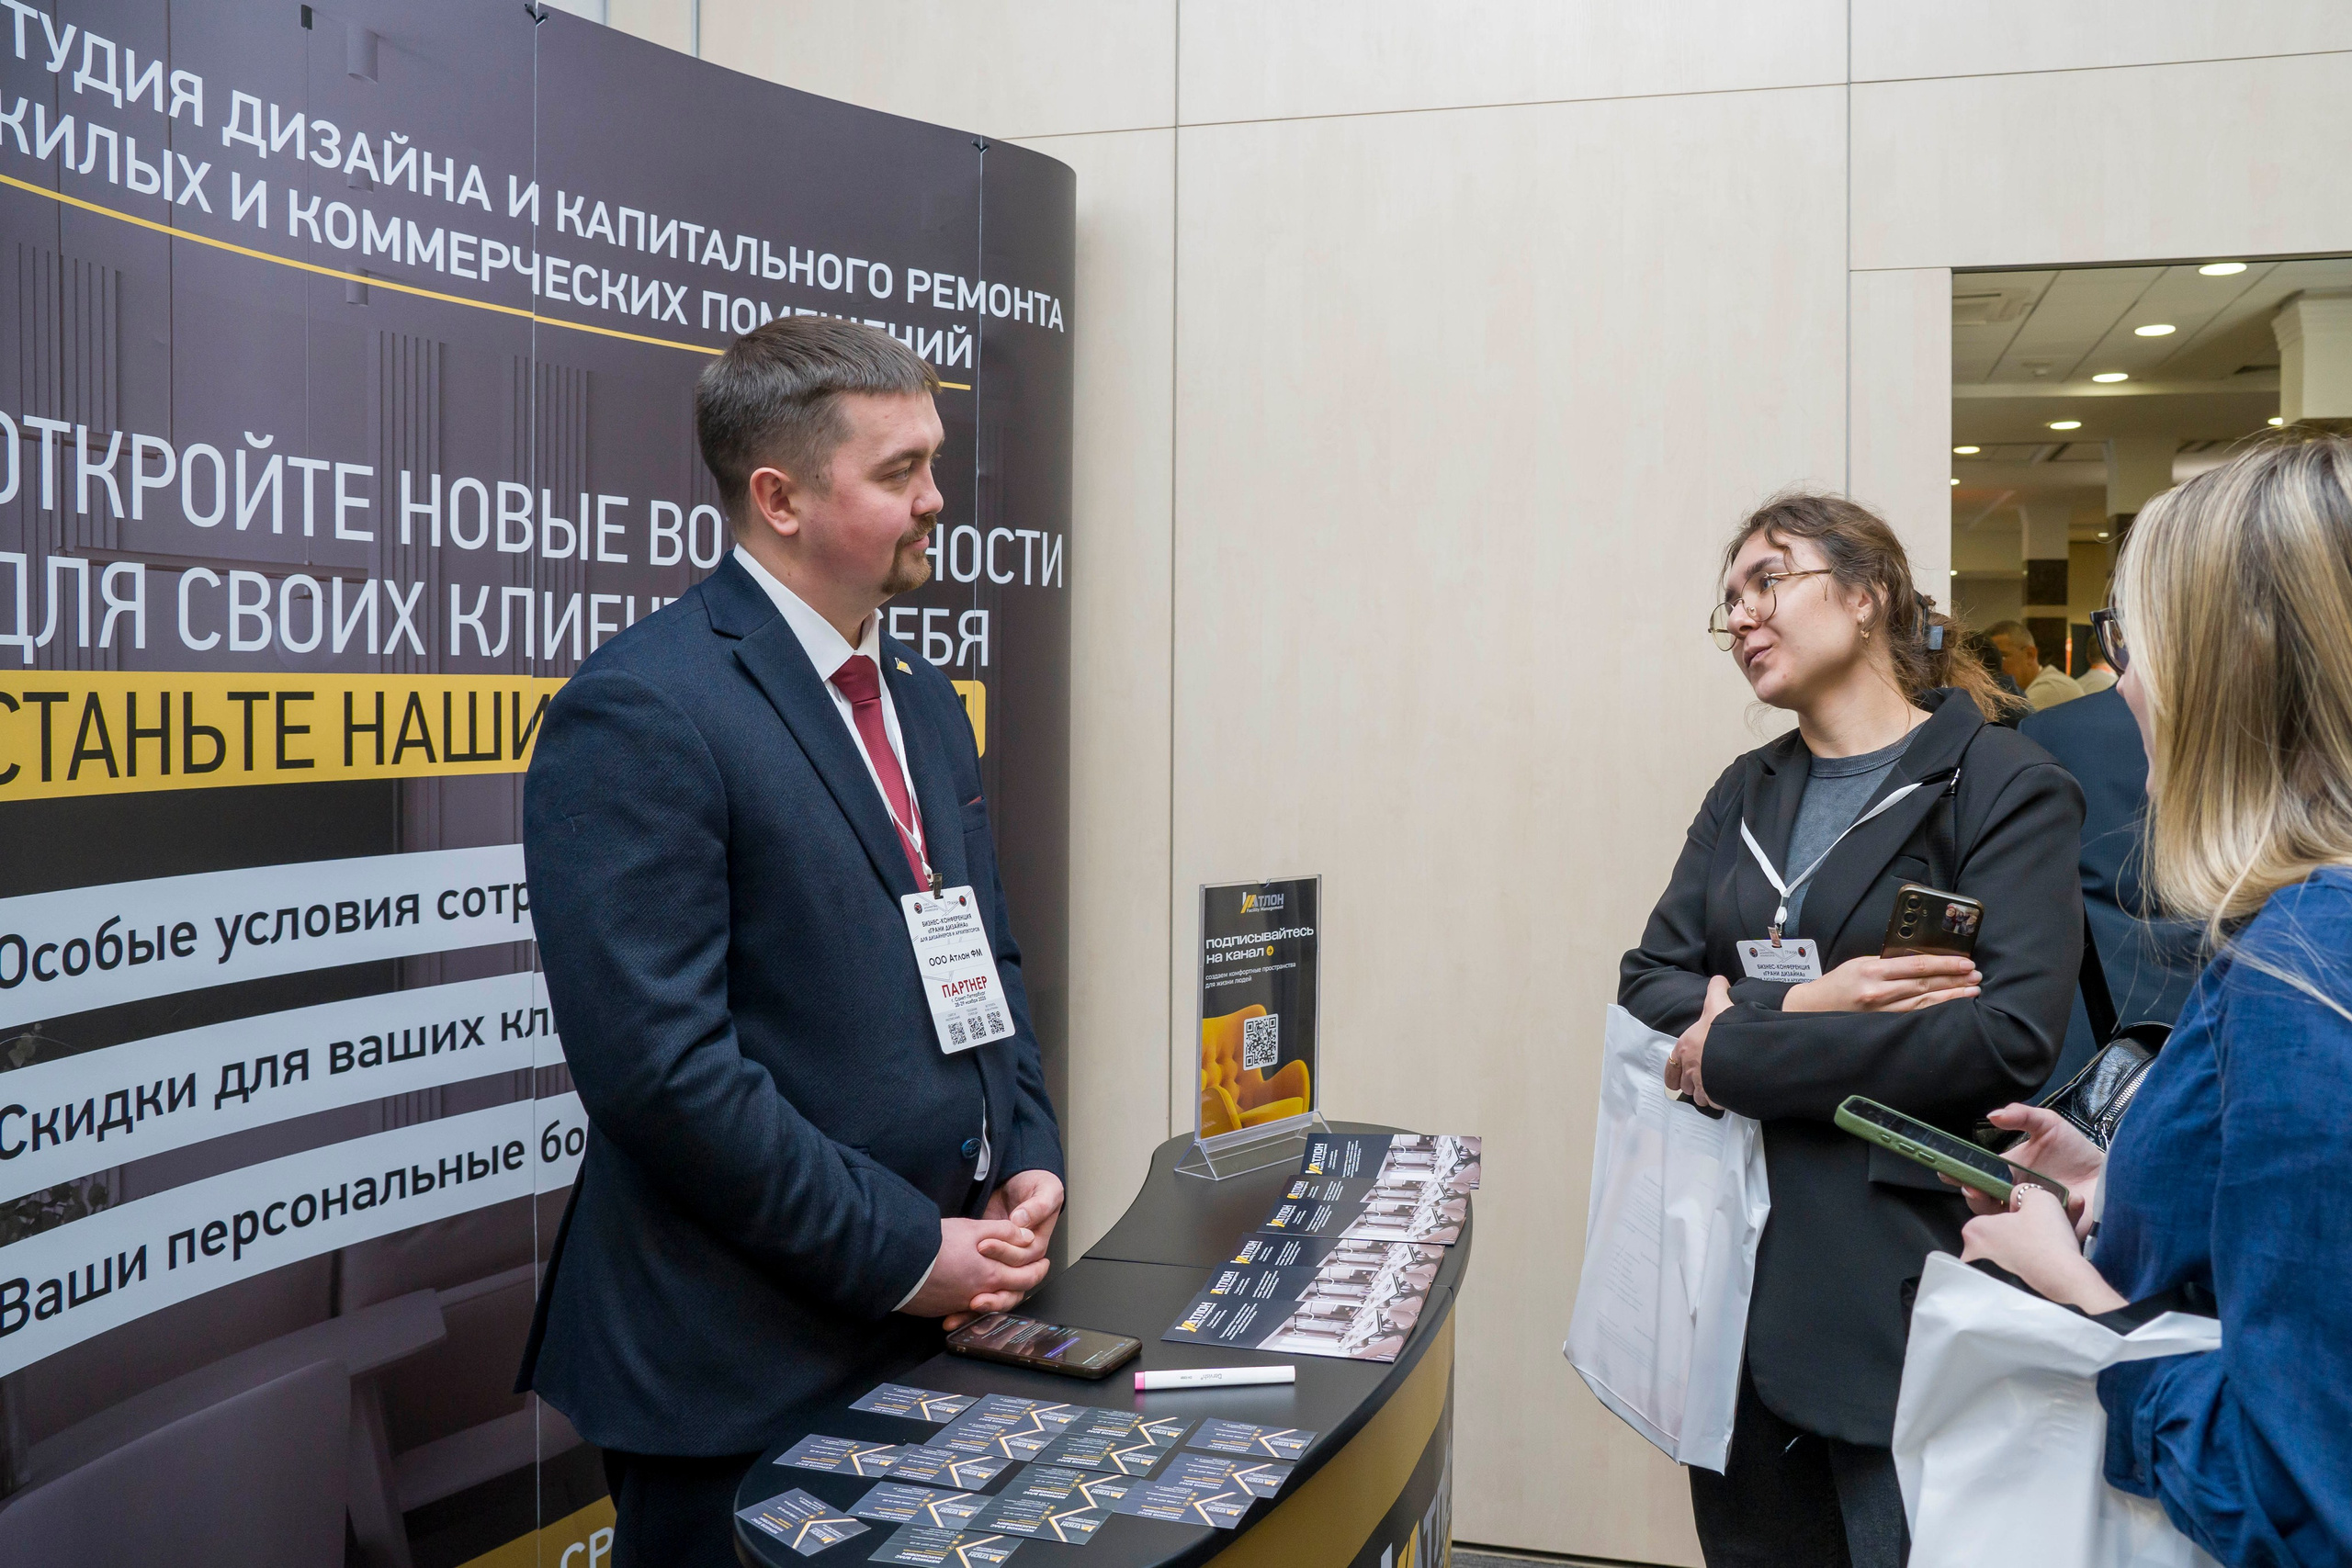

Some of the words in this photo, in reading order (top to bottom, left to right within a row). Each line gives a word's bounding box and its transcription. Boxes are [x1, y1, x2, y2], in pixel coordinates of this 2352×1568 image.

[222, 89, 492, 211] ДИЗАЙНА
[509, 174, 539, 226] И
[557, 190, 893, 299] КАПИТАЛЬНОГО
[907, 267, 1065, 333] РЕМОНТА
[232, 171, 267, 230] И
[288, 188, 688, 325] КОММЕРЧЕСКИХ
[401, 469, 628, 564] НОВЫЕ
[178, 566, 426, 656] СВОИХ
[879, 606, 989, 668] ЕБЯ
[0, 907, 198, 989] Особые
[215, 893, 421, 964] условия
[929, 955, 947, 966] ООО
[949, 952, 970, 963] Атлон
[970, 948, 983, 957] ФМ
[1205, 926, 1315, 950] подписывайтесь
[1205, 953, 1223, 964] на
[1226, 946, 1264, 962] канал
[941, 976, 987, 998] ПАРТНЕР
[0, 1072, 197, 1161] Скидки
[214, 1047, 311, 1105] для
[329, 1015, 486, 1076] ваших
[501, 1007, 559, 1042] кл
[0, 1244, 148, 1338] Ваши
[166, 1137, 526, 1261] персональные
